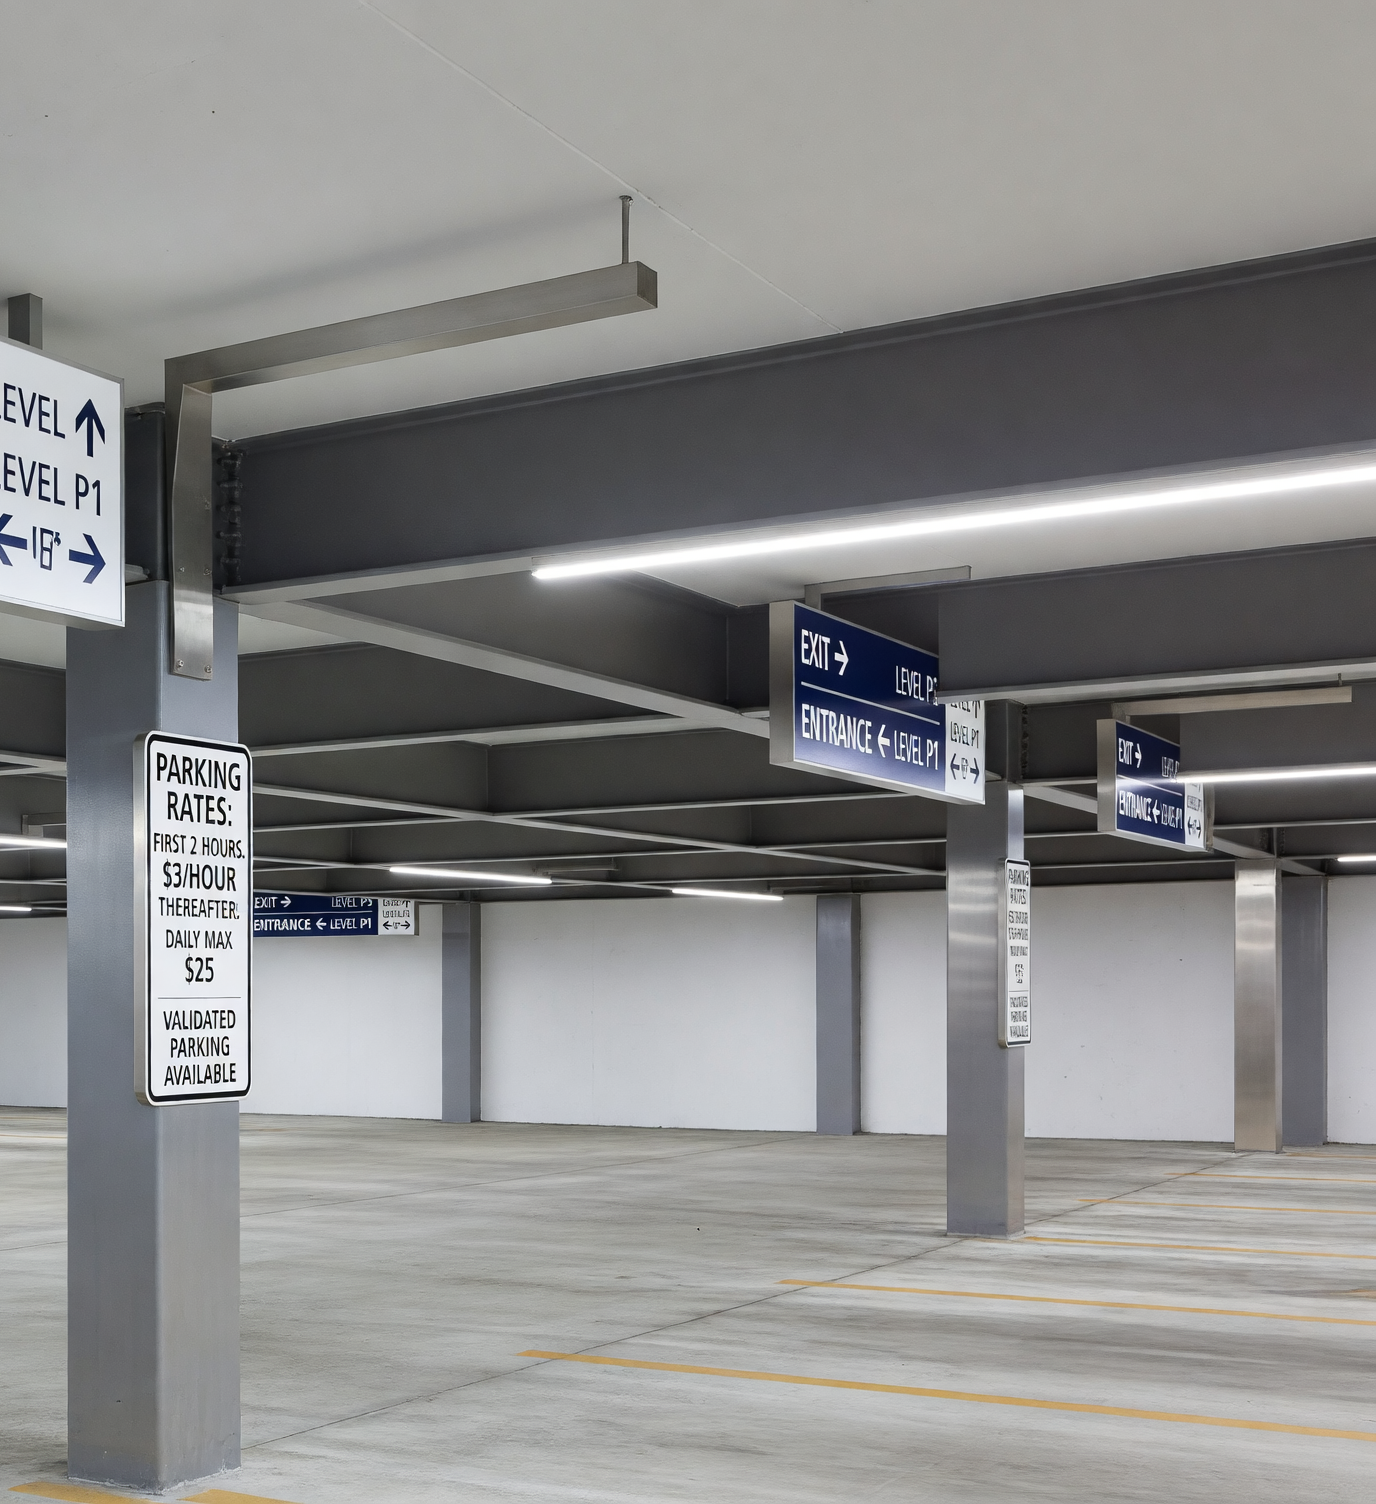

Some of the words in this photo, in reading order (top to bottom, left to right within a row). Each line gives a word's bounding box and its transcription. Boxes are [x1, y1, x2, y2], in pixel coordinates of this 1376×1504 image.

[75, 474, 102, 516] P1
[801, 629, 831, 671] EXIT
[895, 665, 924, 701] LEVEL
[801, 704, 873, 754] ENTRANCE
[894, 730, 924, 766] LEVEL
[926, 739, 939, 770] P1
[1118, 737, 1133, 765] EXIT
[156, 752, 241, 791] PARKING
[167, 791, 232, 827] RATES:
[153, 832, 186, 854] FIRST
[190, 836, 197, 855] 2
[202, 837, 245, 859] HOURS.
[162, 859, 237, 891] $3/HOUR
[254, 896, 278, 908] EXIT
[254, 918, 311, 931] ENTRANCE
[330, 918, 358, 930] LEVEL
[360, 918, 372, 929] P1
[166, 929, 201, 949] DAILY
[205, 930, 233, 950] MAX
[185, 953, 214, 985] $25
[163, 1009, 236, 1031] VALIDATED
[170, 1036, 230, 1059] PARKING
[164, 1063, 237, 1087] AVAILABLE
